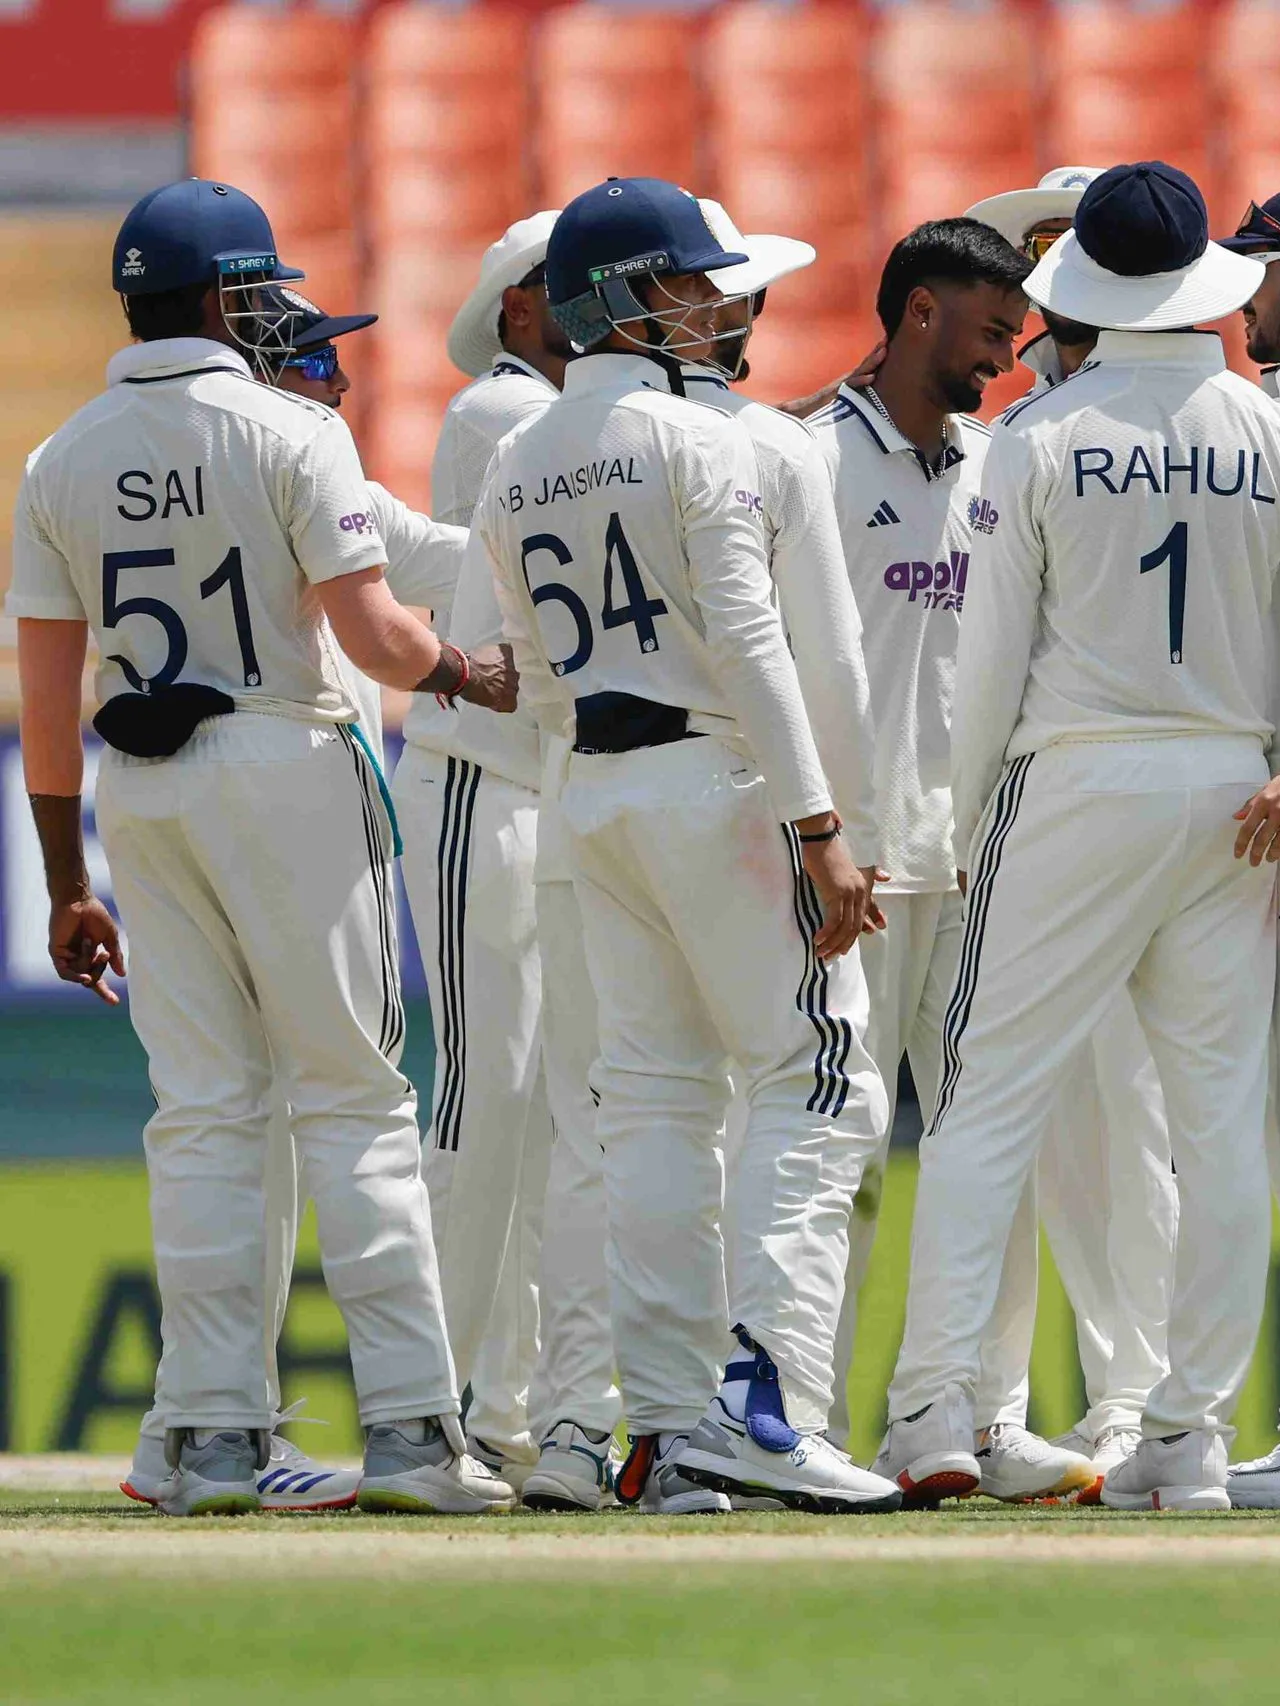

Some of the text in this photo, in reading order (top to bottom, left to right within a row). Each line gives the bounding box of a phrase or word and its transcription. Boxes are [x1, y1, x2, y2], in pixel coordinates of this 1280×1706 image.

[121, 266, 146, 276] SHREY
[238, 258, 266, 269] SHREY
[614, 259, 652, 274] SHREY
[116, 466, 205, 521] SAI
[499, 458, 643, 513] B JAISWAL
[1073, 446, 1276, 504] RAHUL
[103, 546, 262, 693] 51
[521, 512, 669, 677] 64
[1140, 521, 1188, 664] 1
